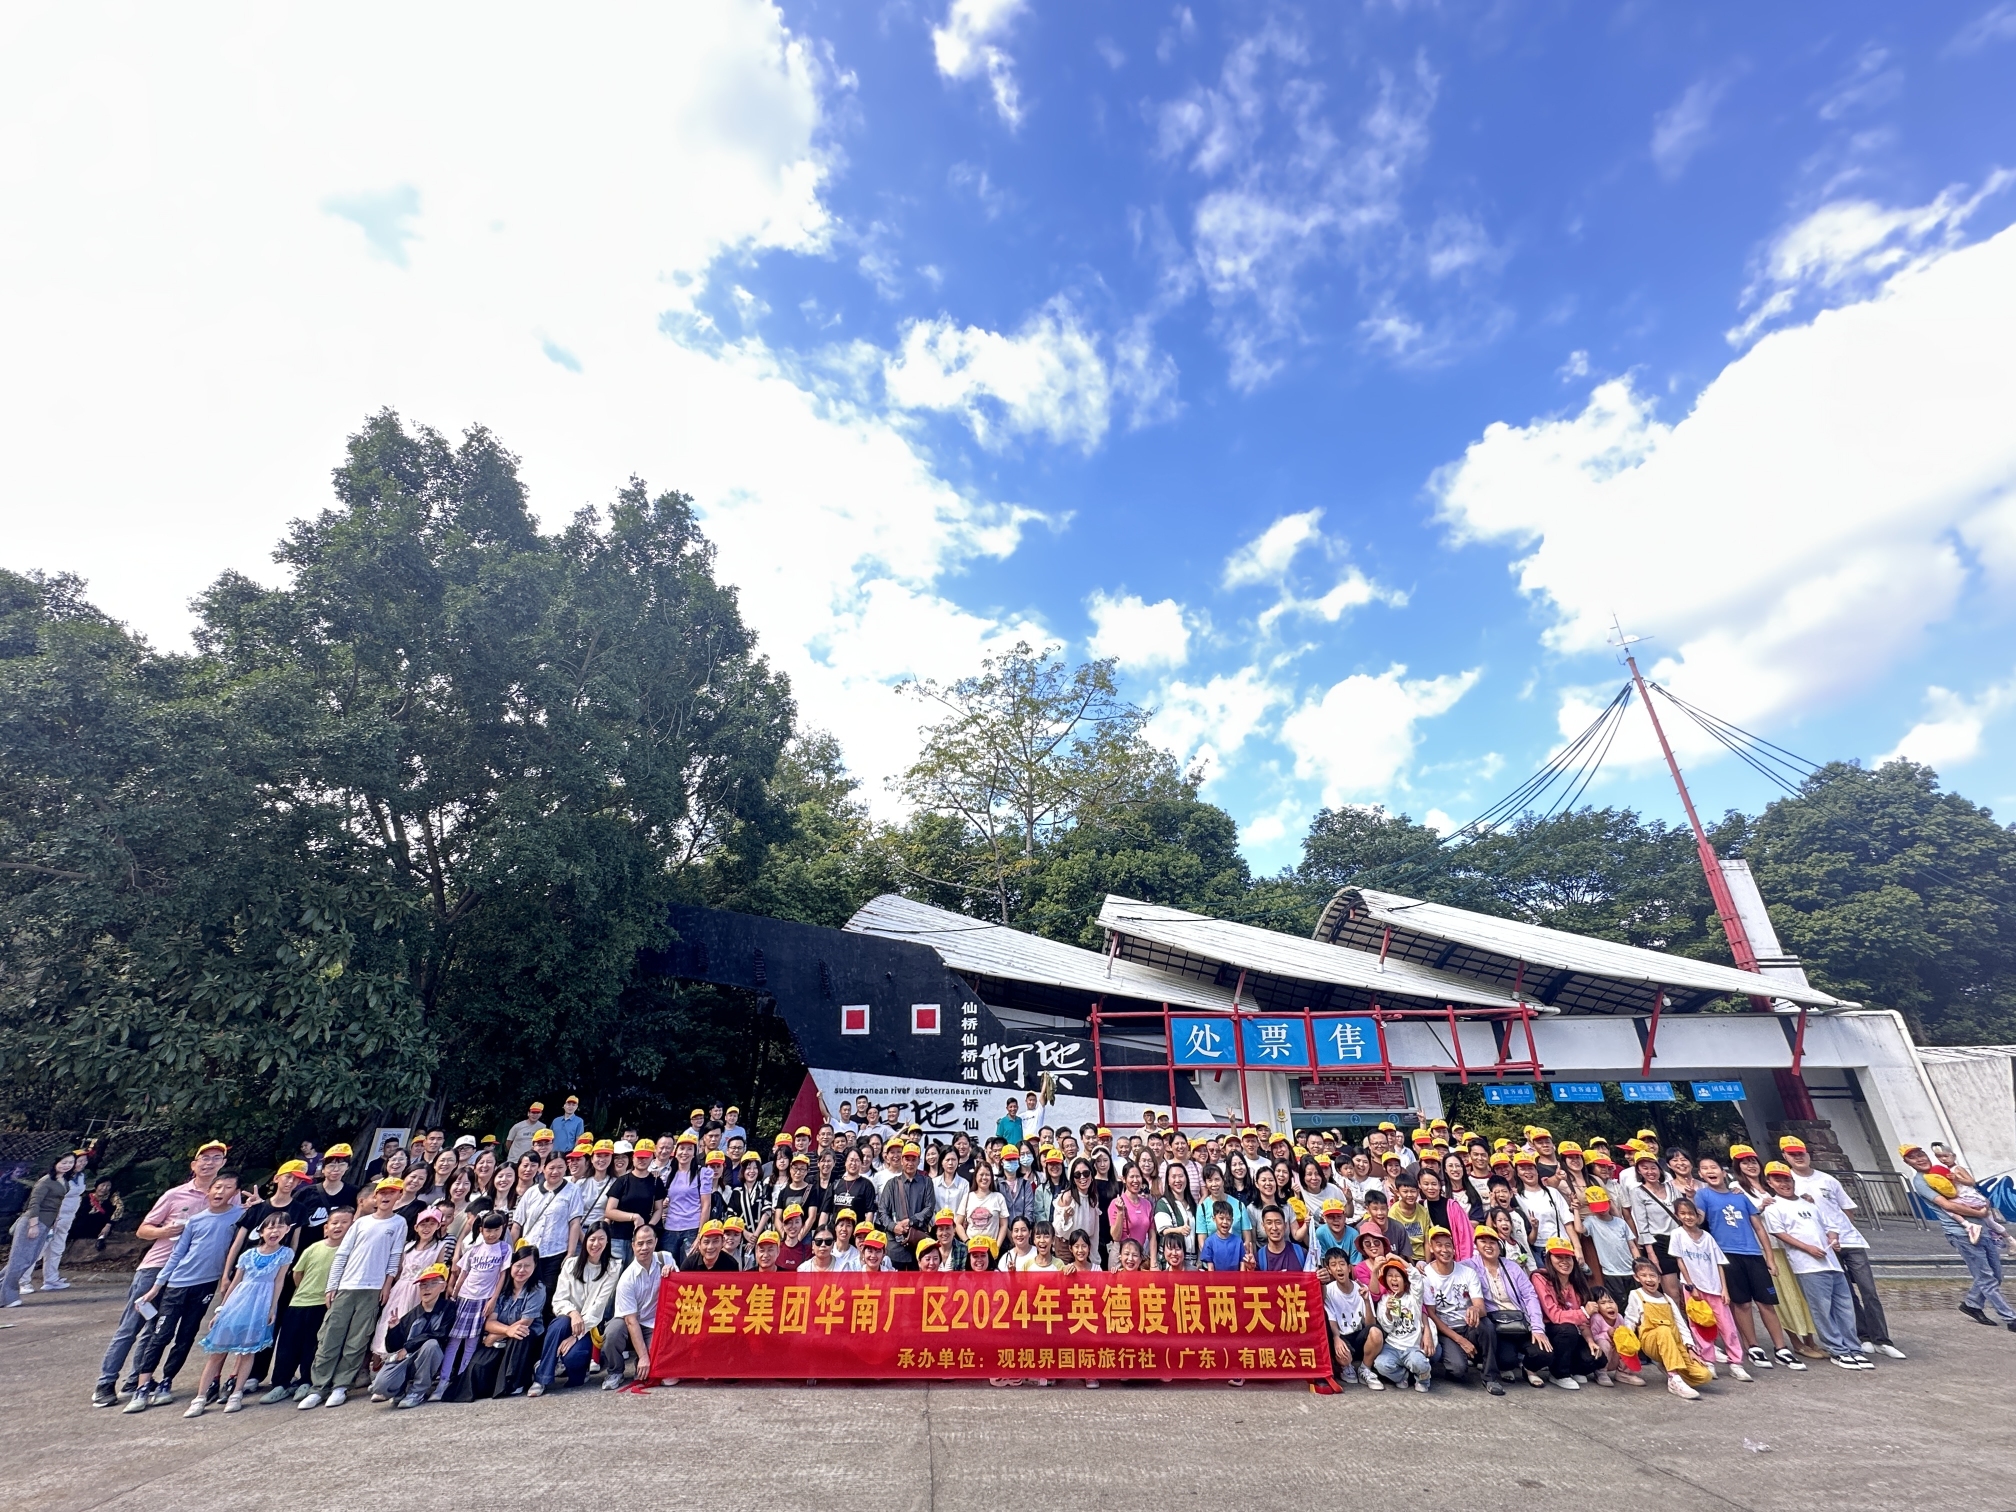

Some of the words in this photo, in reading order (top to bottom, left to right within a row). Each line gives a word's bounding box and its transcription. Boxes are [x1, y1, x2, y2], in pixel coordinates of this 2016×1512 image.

[834, 1086, 889, 1095] subterranean
[890, 1086, 911, 1095] river
[915, 1086, 971, 1095] subterranean
[972, 1087, 992, 1096] river
[671, 1283, 1310, 1335] 瀚荃集团华南厂区2024年英德度假两天游
